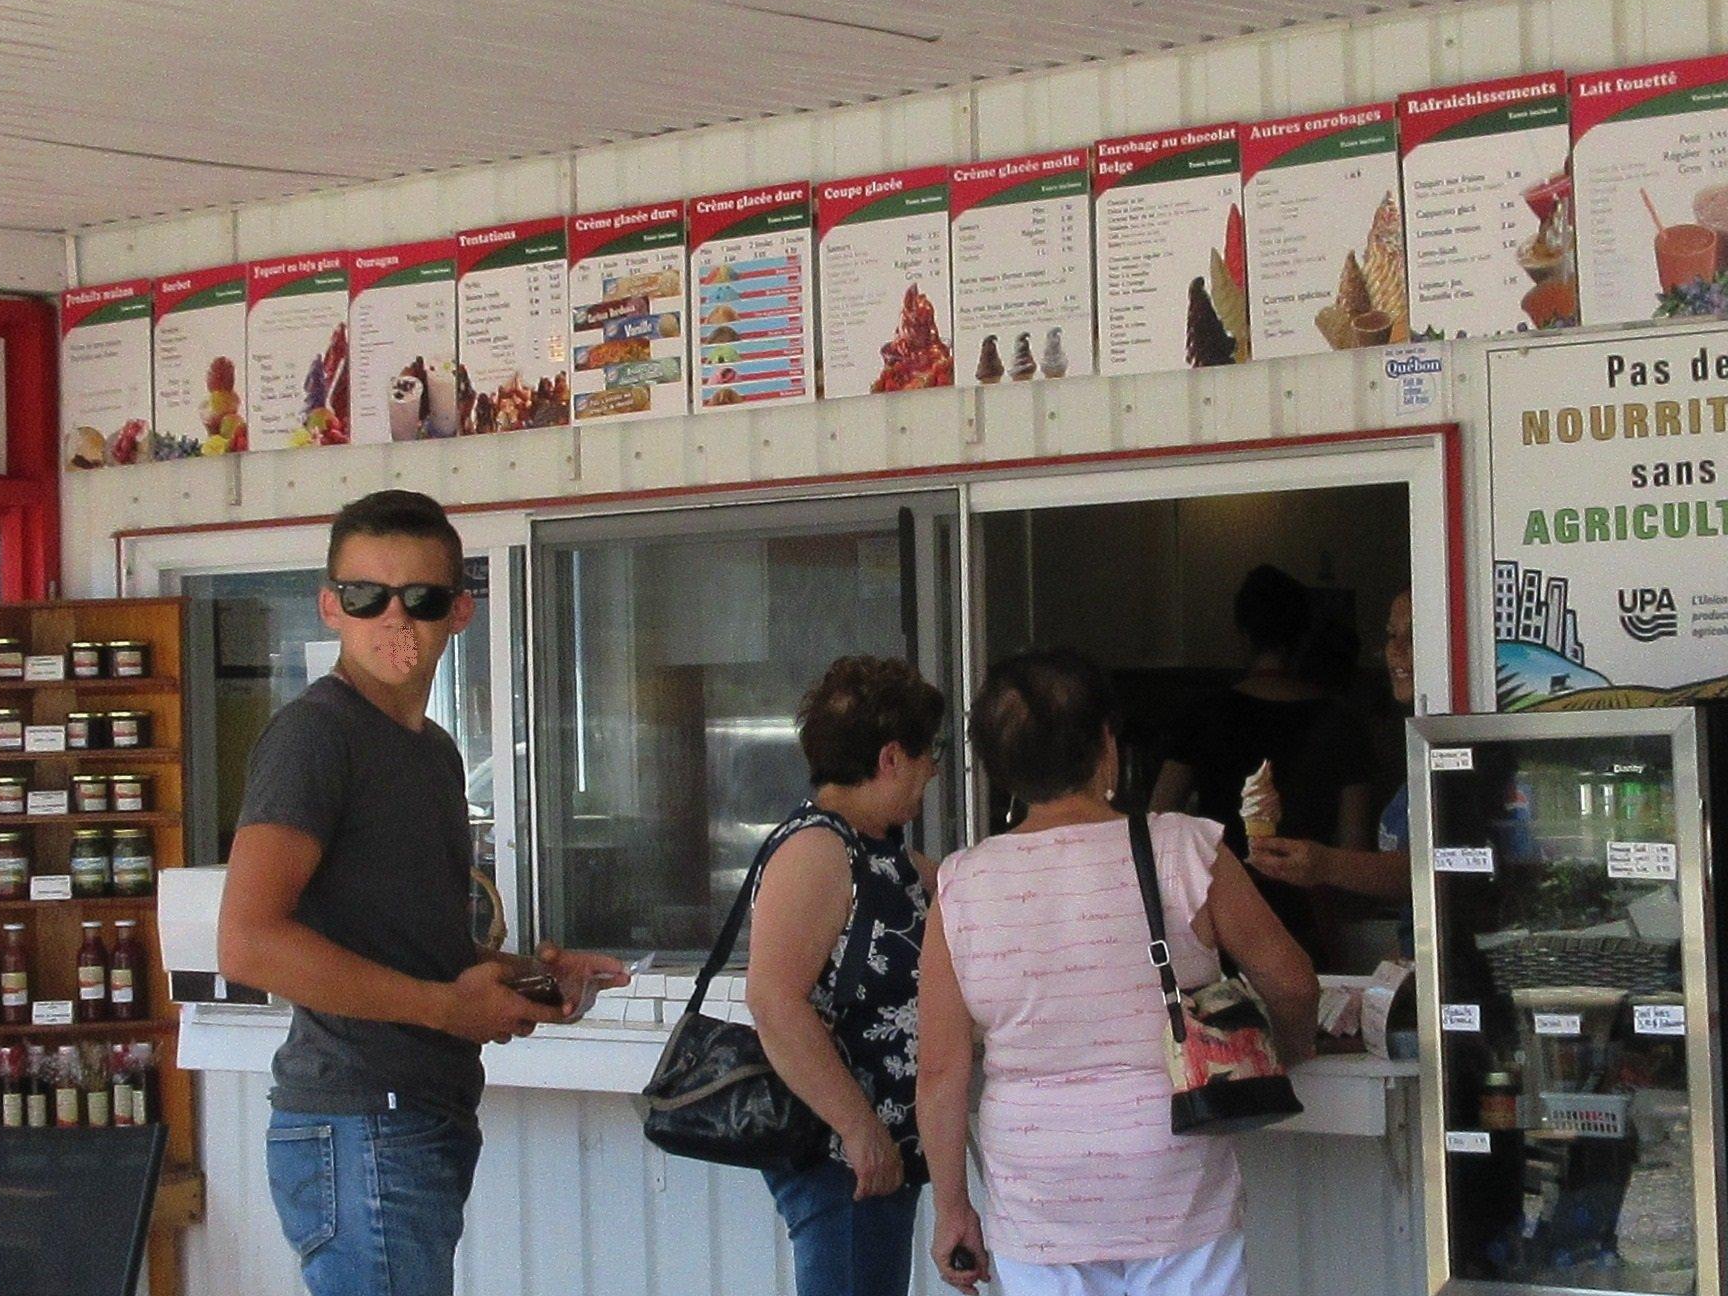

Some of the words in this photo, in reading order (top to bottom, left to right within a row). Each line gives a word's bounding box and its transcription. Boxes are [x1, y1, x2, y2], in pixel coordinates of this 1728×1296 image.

[1579, 80, 1612, 97] Lait
[1616, 71, 1678, 93] fouetté
[1249, 122, 1300, 140] Autres
[1305, 109, 1381, 131] enrobages
[1098, 136, 1159, 157] Enrobage
[1161, 135, 1178, 149] au
[1180, 128, 1236, 147] chocolat
[954, 165, 996, 182] Crème
[998, 160, 1039, 178] glacée
[1042, 154, 1080, 170] molle
[1099, 159, 1134, 176] Belge
[696, 200, 734, 214] Crème
[736, 194, 772, 210] glacée
[775, 188, 803, 202] dure
[824, 185, 862, 201] Coupe
[864, 178, 902, 195] glacée
[575, 217, 611, 232] Crème
[613, 212, 649, 228] glacée
[650, 207, 678, 221] dure
[459, 229, 516, 247] Tentations
[623, 320, 653, 337] Vanille
[1386, 357, 1440, 378] Québon
[1607, 354, 1671, 388] Pas
[1631, 459, 1717, 488] sans
[1617, 588, 1677, 614] UPA
